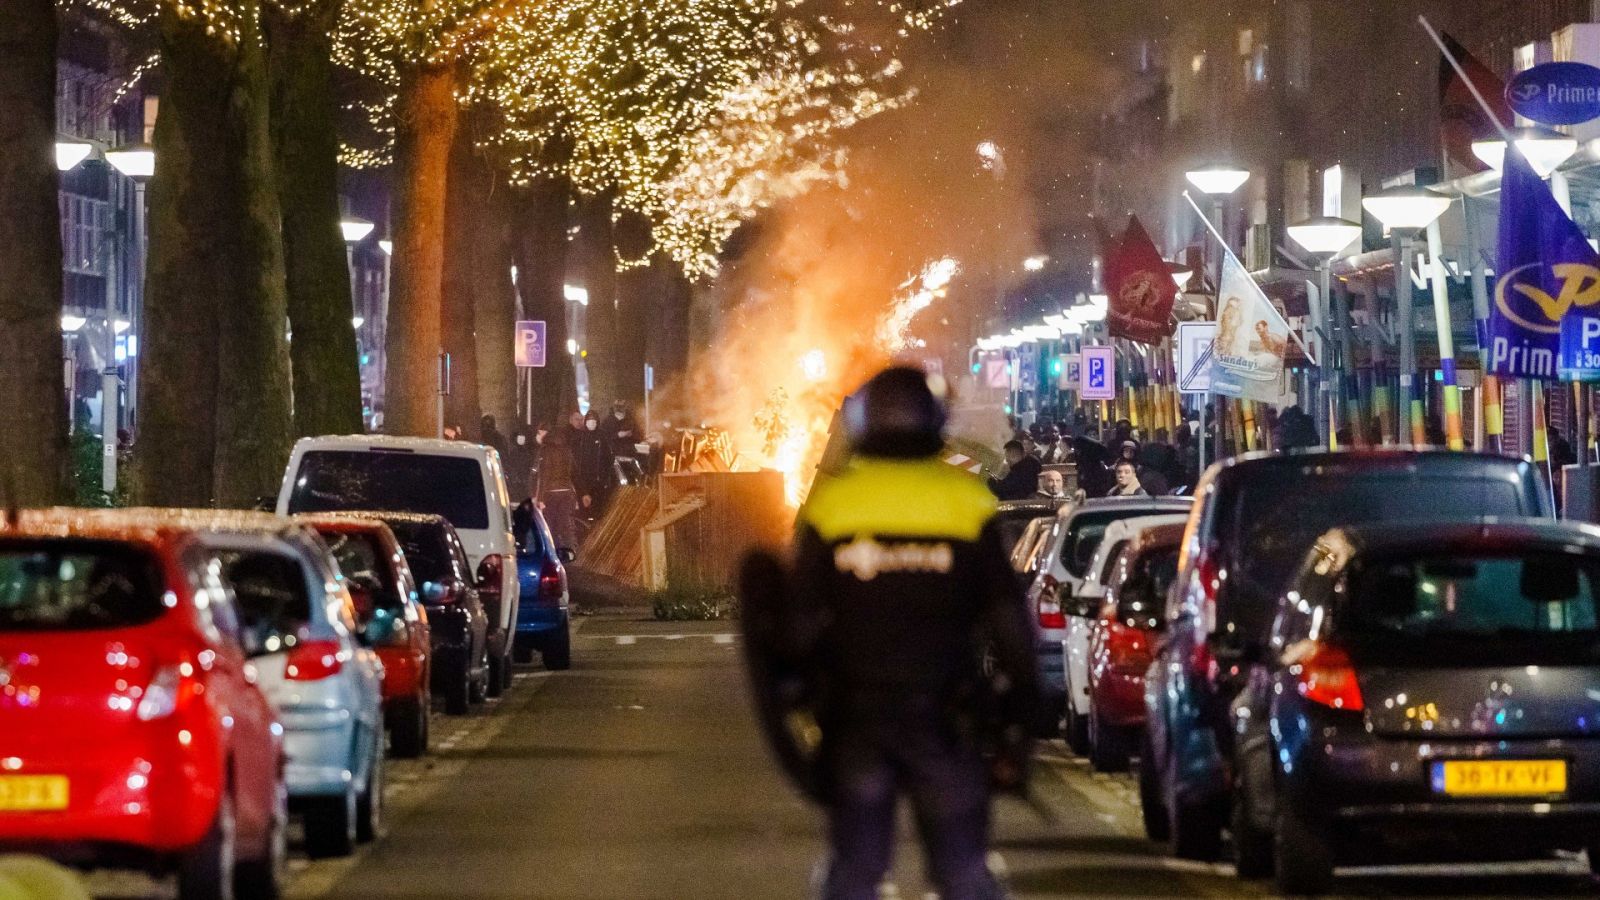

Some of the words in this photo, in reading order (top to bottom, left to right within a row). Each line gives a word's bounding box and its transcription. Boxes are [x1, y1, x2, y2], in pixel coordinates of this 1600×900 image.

[519, 329, 538, 360] P
[1582, 317, 1600, 349] P
[1092, 359, 1101, 375] P
